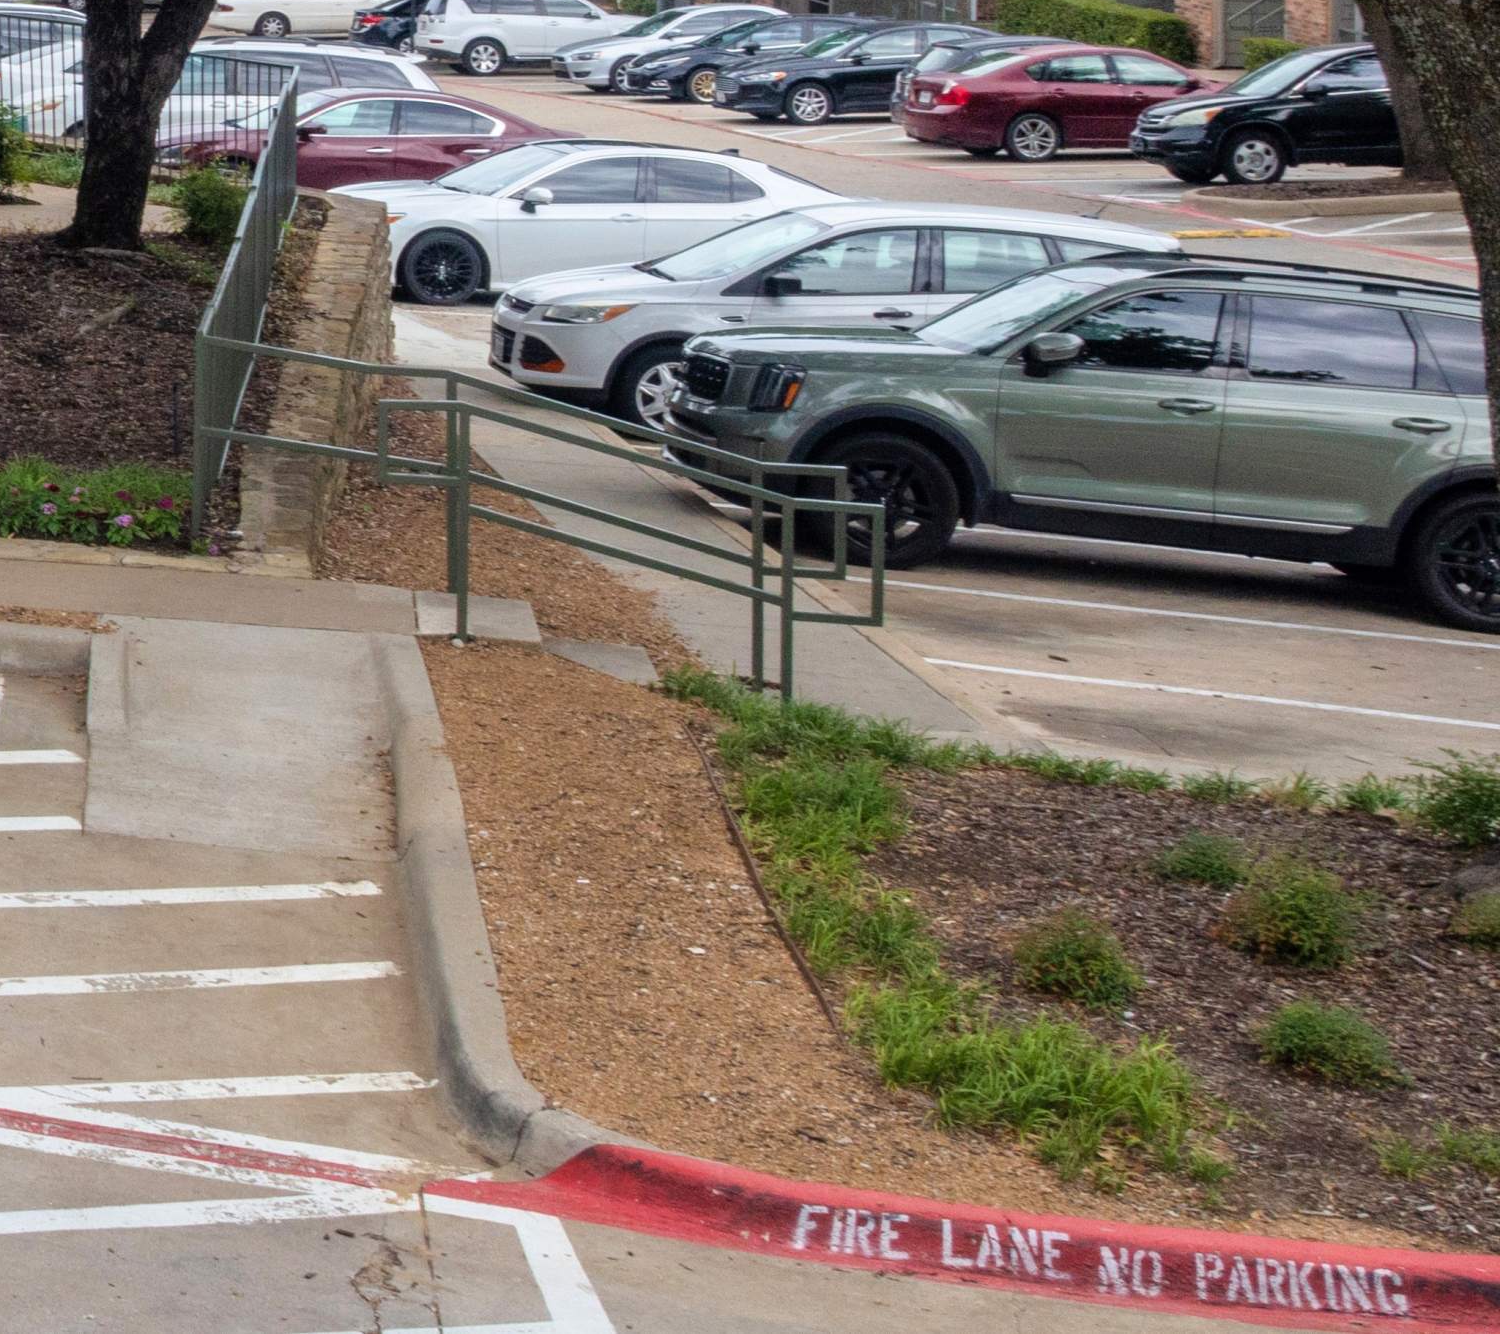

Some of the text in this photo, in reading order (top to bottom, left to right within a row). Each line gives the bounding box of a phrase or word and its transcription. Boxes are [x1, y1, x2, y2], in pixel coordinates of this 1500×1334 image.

[791, 1203, 1406, 1316] FIRE LANE NO PARKING
